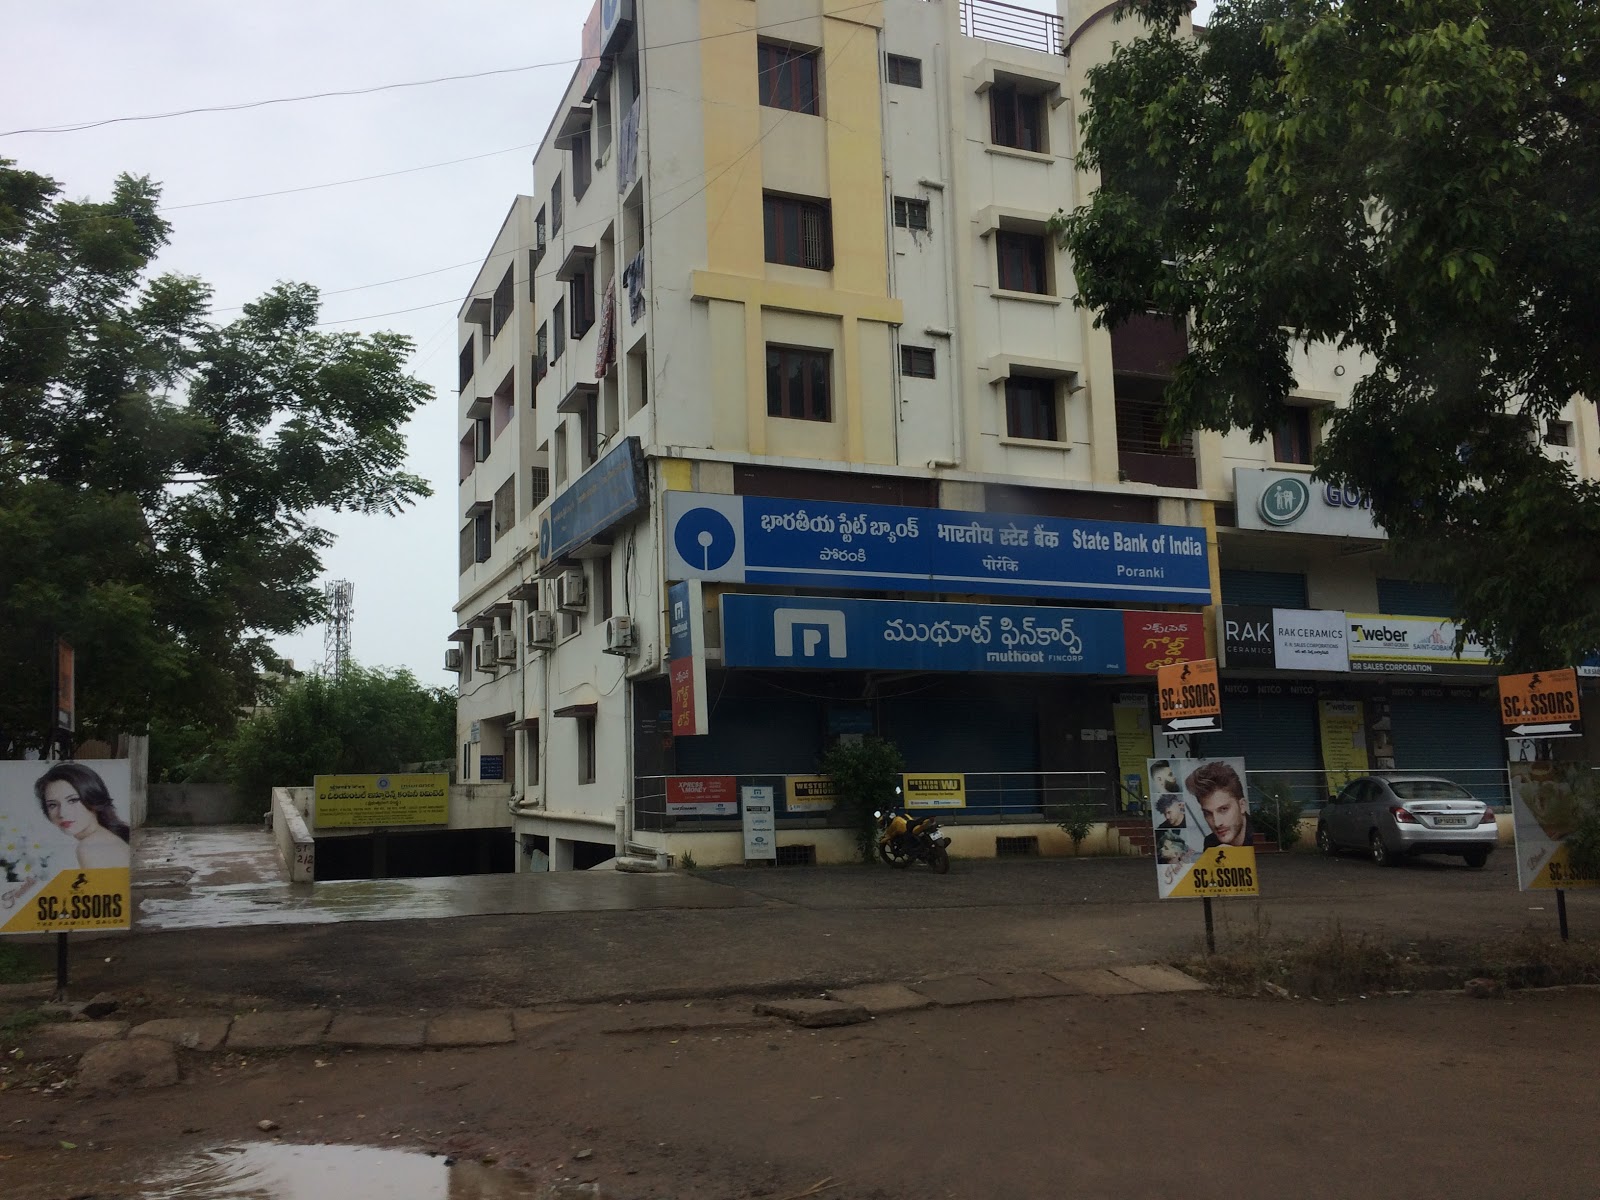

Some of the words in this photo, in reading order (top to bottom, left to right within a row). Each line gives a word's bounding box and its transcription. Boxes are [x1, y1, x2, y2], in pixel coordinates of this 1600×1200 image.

[761, 510, 835, 532] భారతీయ
[837, 513, 867, 543] స్టేట్
[870, 517, 919, 543] బ్యాంక్
[937, 522, 993, 545] भारतीय
[999, 523, 1028, 547] स्टेट
[1034, 524, 1059, 548] बैंक
[1072, 529, 1110, 551] State
[1113, 531, 1148, 553] Bank
[1152, 534, 1165, 554] of
[1170, 535, 1202, 556] India
[819, 548, 866, 562] పోరంకి
[982, 555, 1019, 572] पोरंकि
[1117, 565, 1164, 579] Poranki
[884, 616, 993, 647] ముథూట్
[1225, 620, 1271, 642] RAK
[1278, 627, 1296, 637] RAK
[1297, 628, 1343, 639] CERAMICS
[1363, 626, 1408, 641] weber
[1143, 637, 1190, 656] గోల్డ్
[1227, 646, 1272, 654] CERAMICS
[987, 650, 1044, 663] muthoot
[1048, 654, 1084, 662] FINCORP
[1352, 662, 1362, 670] RR
[1363, 663, 1384, 671] SALES
[1385, 664, 1432, 672] CORPORATION
[1224, 685, 1248, 693] NITCO
[1258, 685, 1281, 694] NITCO
[1291, 686, 1314, 694] NITCO
[941, 780, 958, 790] WU
